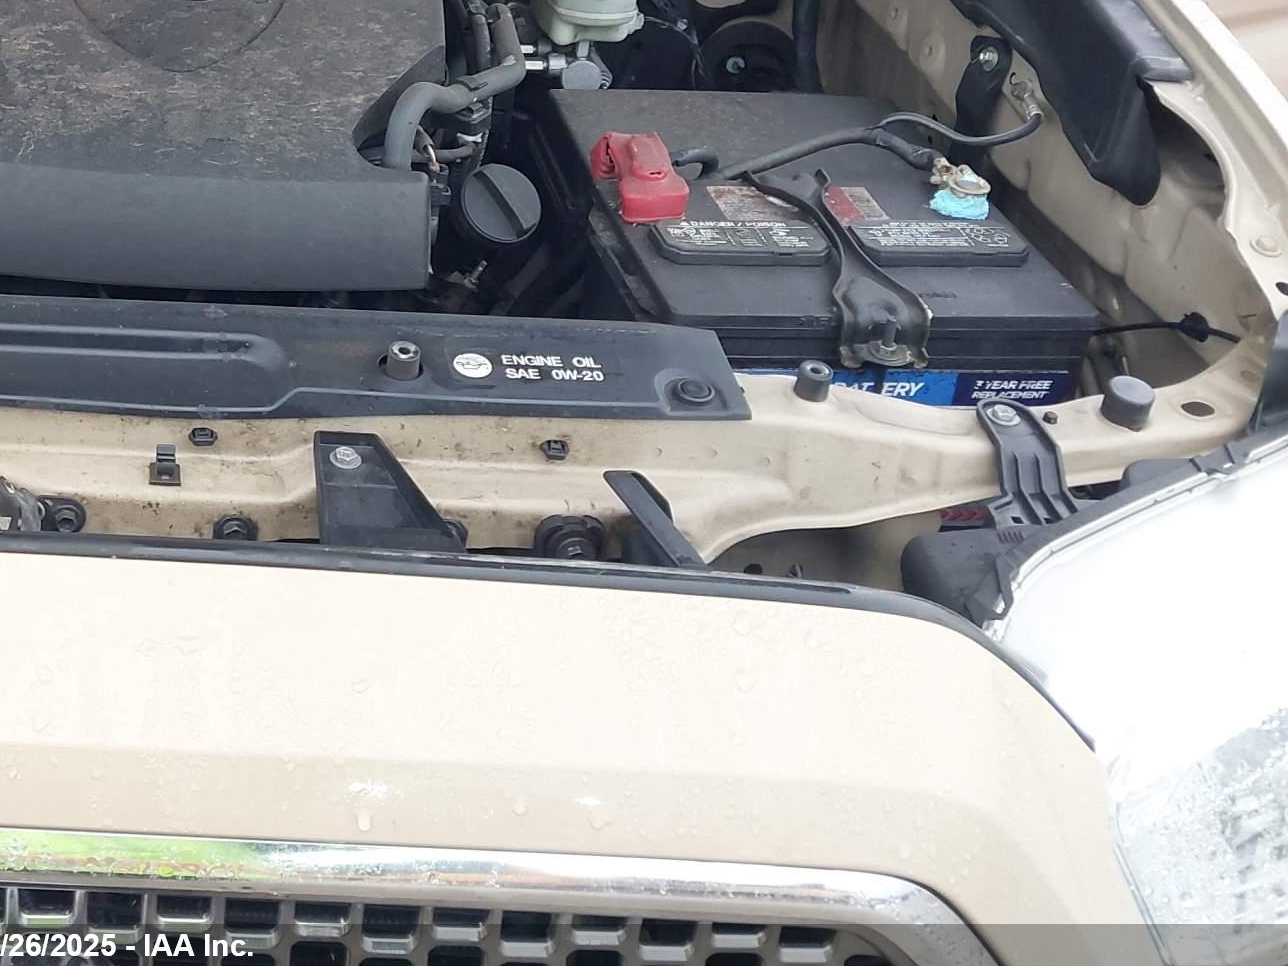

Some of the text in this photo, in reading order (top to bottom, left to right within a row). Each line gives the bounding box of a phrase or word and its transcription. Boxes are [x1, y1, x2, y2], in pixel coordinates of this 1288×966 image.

[500, 354, 602, 368] ENGINE OIL
[505, 368, 604, 381] SAE 0W-20
[984, 380, 1018, 390] YEAR
[1018, 380, 1053, 390] FREE
[971, 391, 1050, 399] REPLACEMENT
